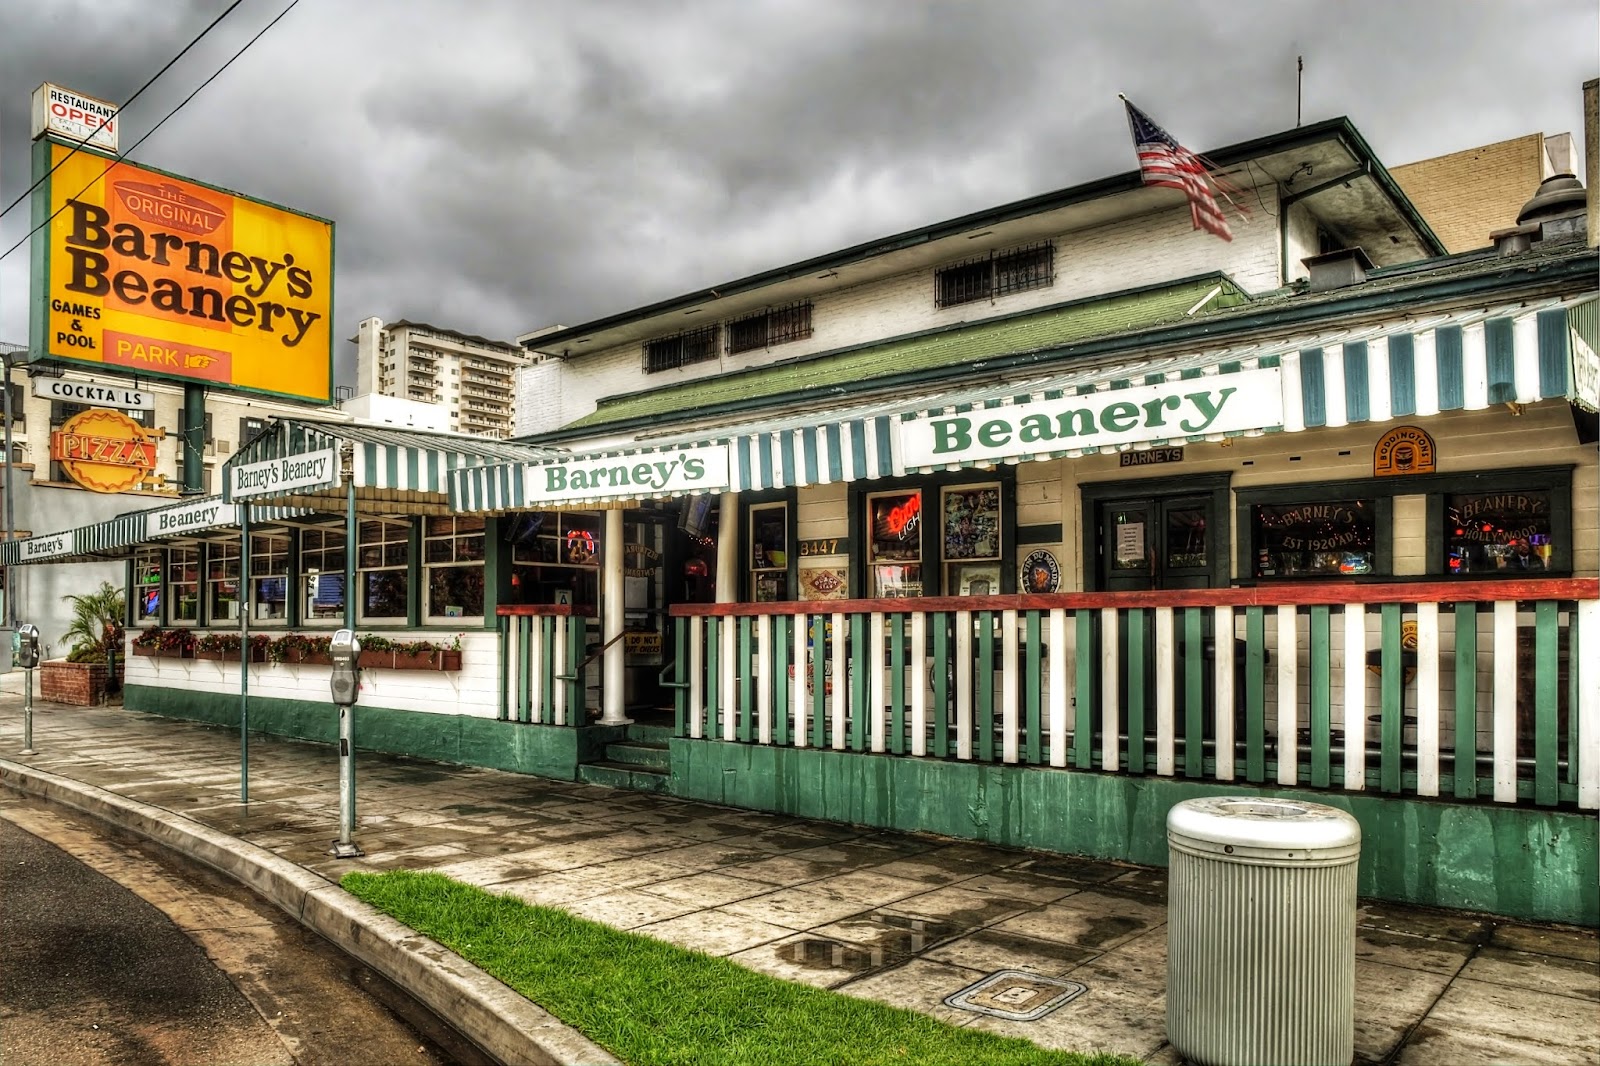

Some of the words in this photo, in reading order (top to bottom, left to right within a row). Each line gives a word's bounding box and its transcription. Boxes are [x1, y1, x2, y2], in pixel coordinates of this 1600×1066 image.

[51, 90, 115, 118] RESTAURANT
[51, 103, 113, 133] OPEN
[158, 188, 187, 204] THE
[126, 195, 214, 231] ORIGINAL
[66, 198, 313, 299] Barney's
[52, 298, 101, 320] GAMES
[64, 246, 321, 347] Beanery
[70, 319, 83, 332] &
[57, 332, 96, 349] POOL
[117, 339, 180, 367] PARK
[929, 386, 1238, 455] Beanery
[63, 435, 149, 467] PIZZA
[1122, 449, 1182, 466] BARNEYS
[1380, 431, 1429, 461] BODDINGTONS
[236, 462, 279, 491] Barney's
[281, 453, 327, 483] Beanery
[544, 453, 705, 492] Barney's
[158, 504, 220, 530] Beanery
[1463, 495, 1541, 519] BEANERY
[898, 511, 921, 541] LIGH
[1464, 525, 1537, 542] HOLLYWOOD
[27, 535, 63, 556] Barney's
[1033, 551, 1045, 560] DU
[1282, 536, 1303, 550] EST
[1307, 538, 1336, 551] 1920
[814, 576, 838, 586] BLACK
[644, 636, 658, 644] NOT
